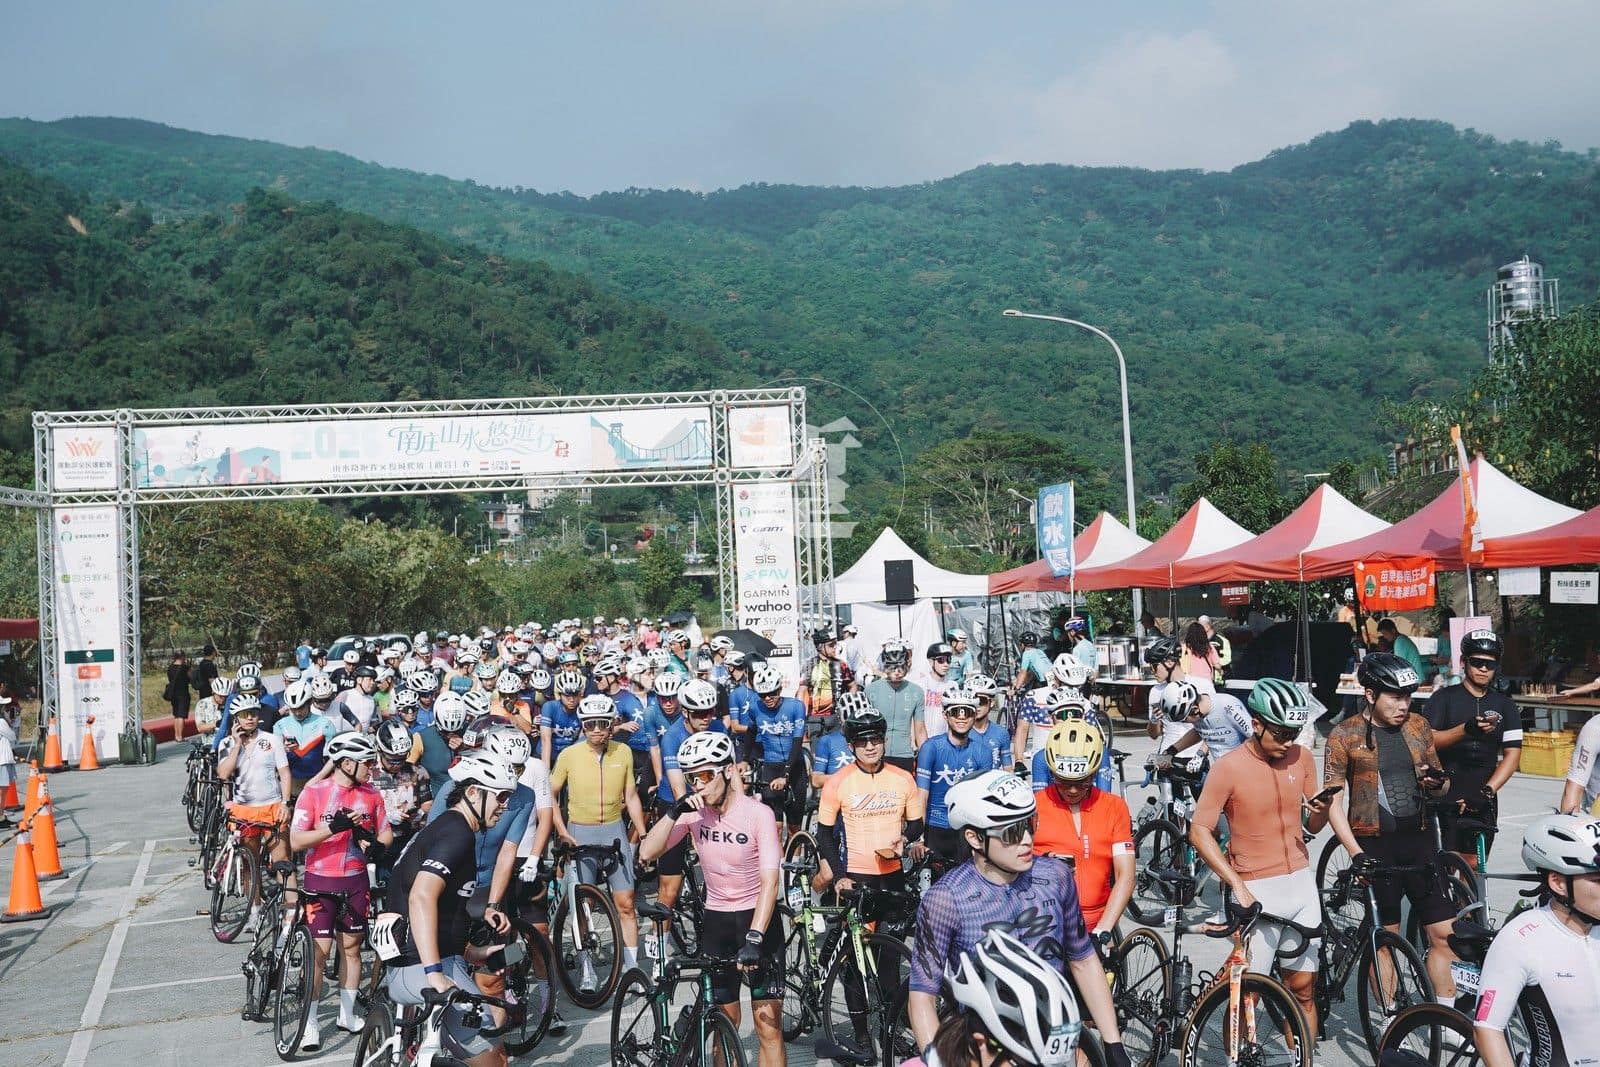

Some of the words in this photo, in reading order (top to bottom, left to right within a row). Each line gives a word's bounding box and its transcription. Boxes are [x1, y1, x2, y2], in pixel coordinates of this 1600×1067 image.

[743, 589, 790, 598] GARMIN
[745, 600, 792, 612] wahoo
[745, 618, 761, 626] DT
[1233, 712, 1250, 732] UBS
[699, 828, 749, 845] NEKO
[1131, 934, 1156, 949] roval
[1184, 1024, 1198, 1067] oval
